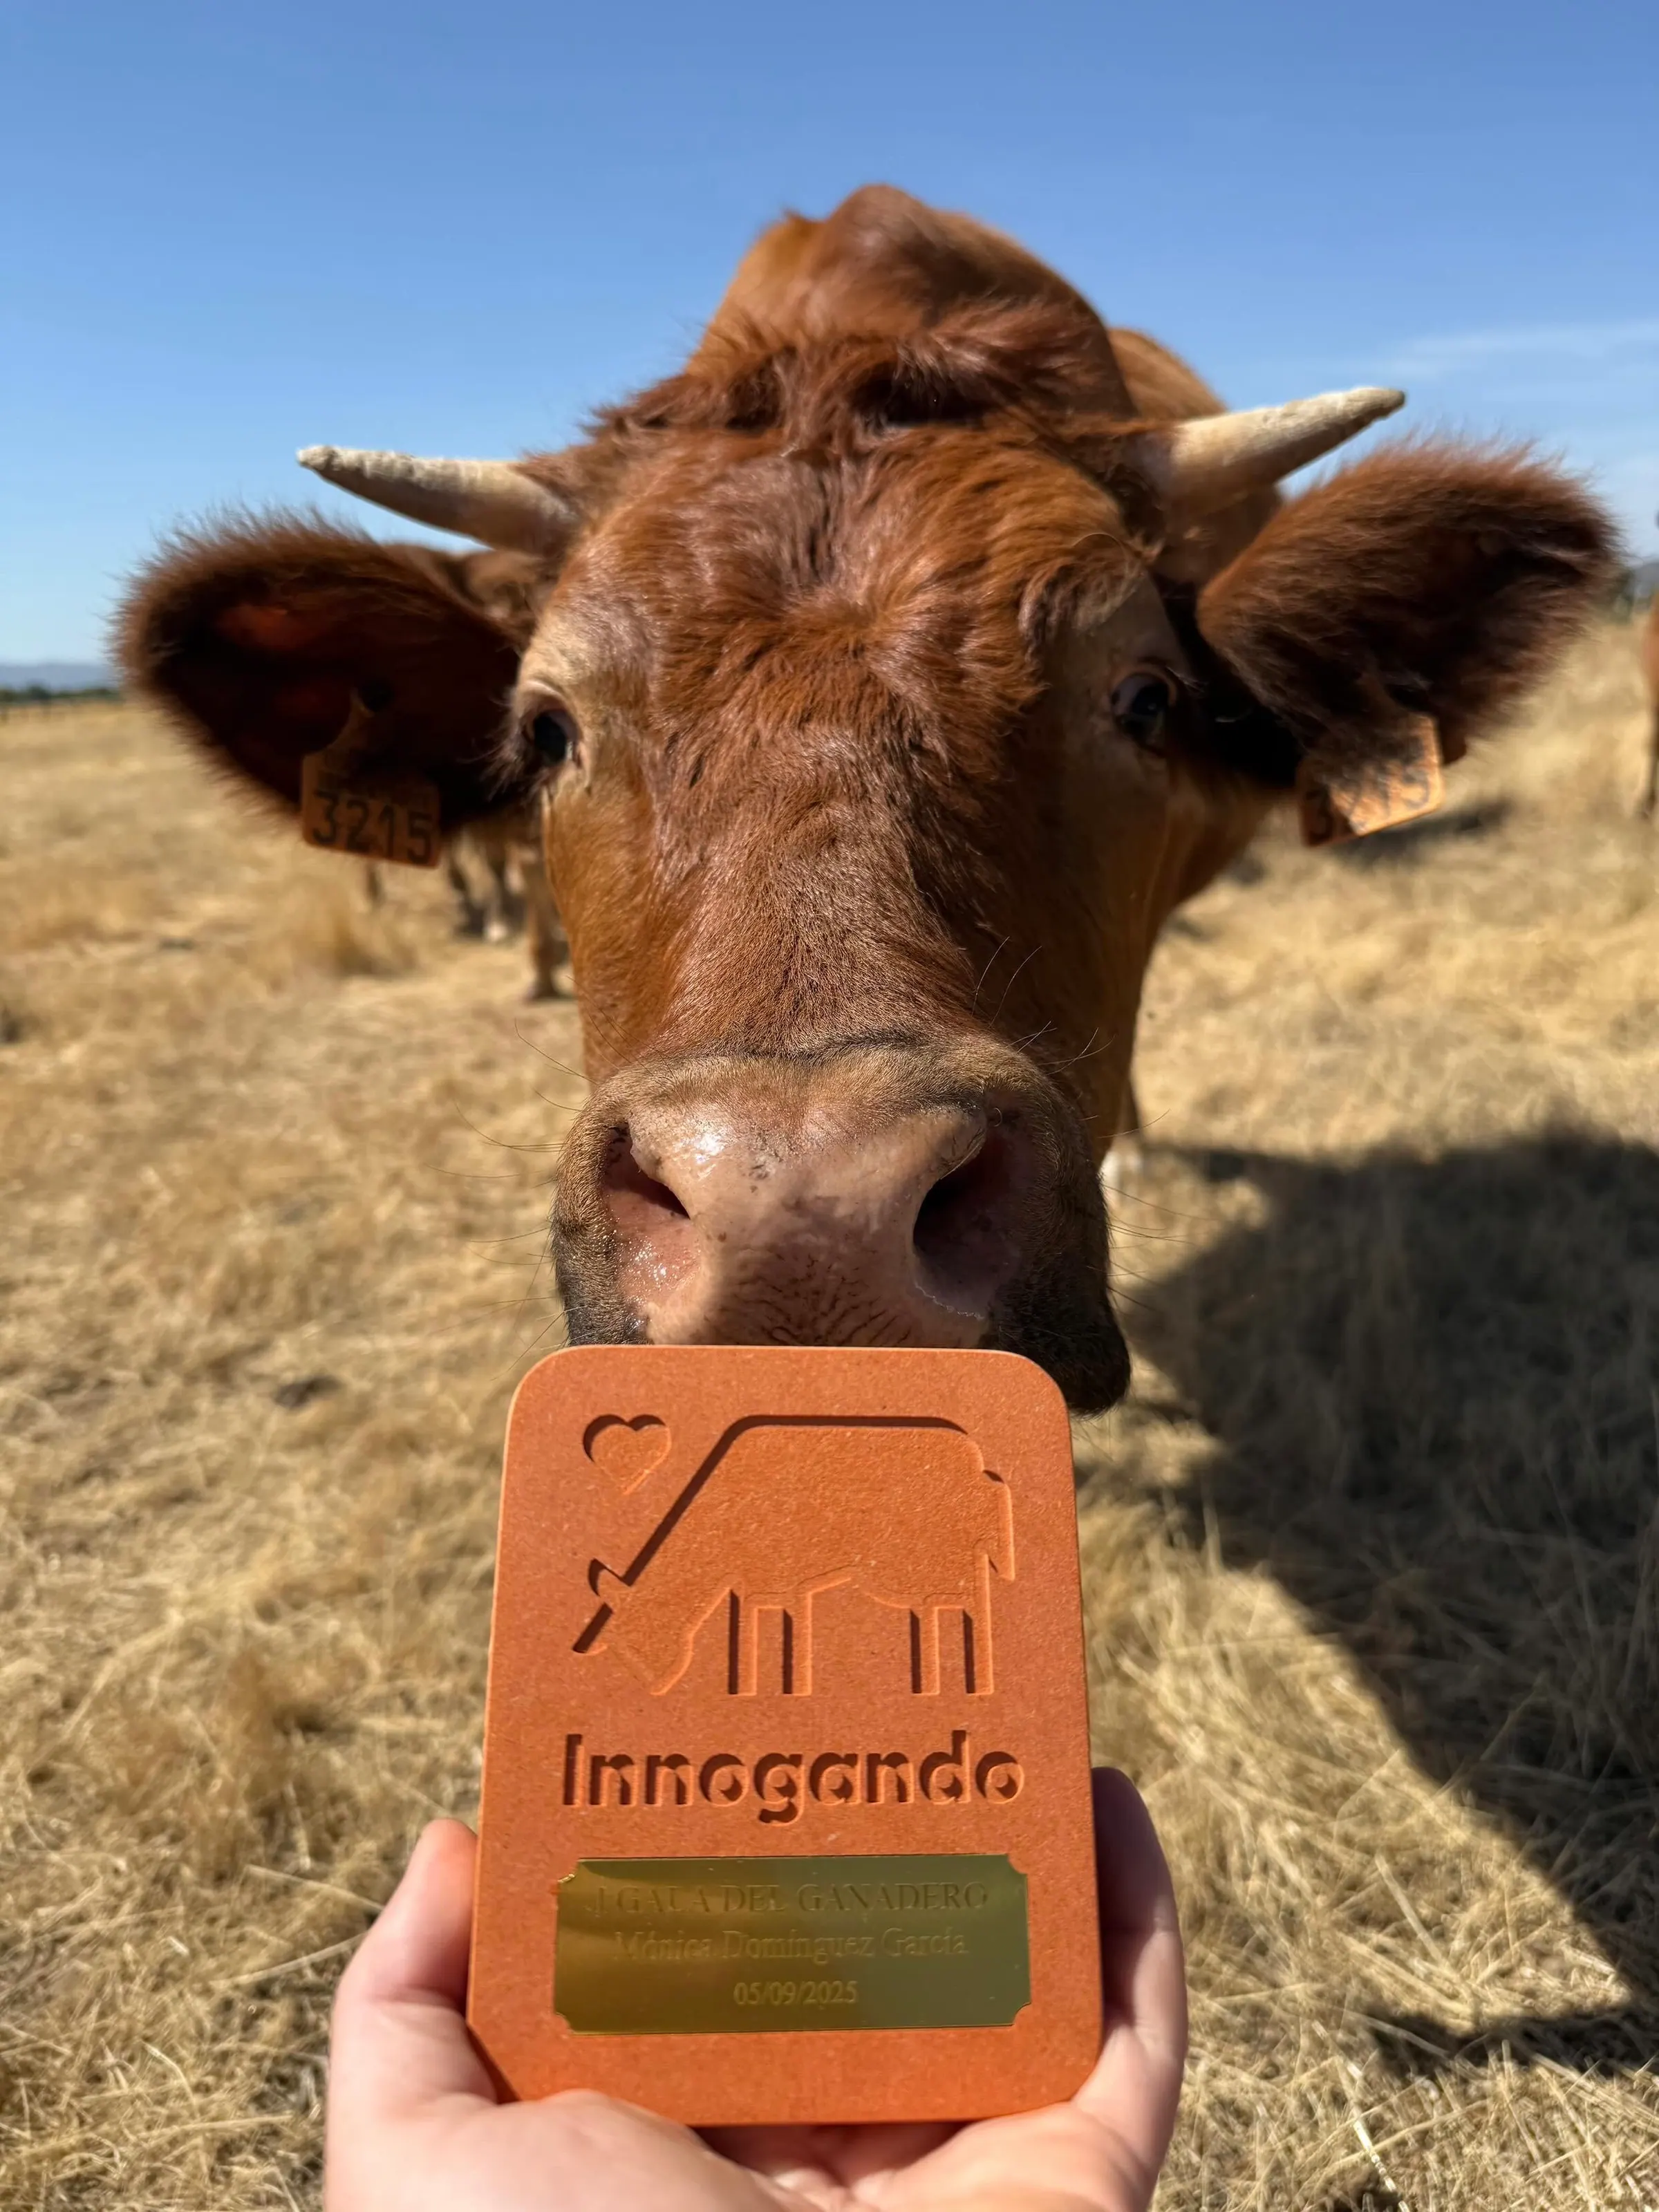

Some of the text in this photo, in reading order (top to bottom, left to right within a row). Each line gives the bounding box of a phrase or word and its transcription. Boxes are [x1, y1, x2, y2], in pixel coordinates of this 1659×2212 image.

[312, 789, 433, 865] 3215
[562, 1730, 1025, 1826] Innogando
[616, 1885, 711, 1913] GALA
[720, 1884, 789, 1911] DEL
[796, 1881, 988, 1911] GANADERO
[613, 1926, 970, 1966] Mónica Domínguez García
[733, 1979, 859, 2007] 05/09/2025
